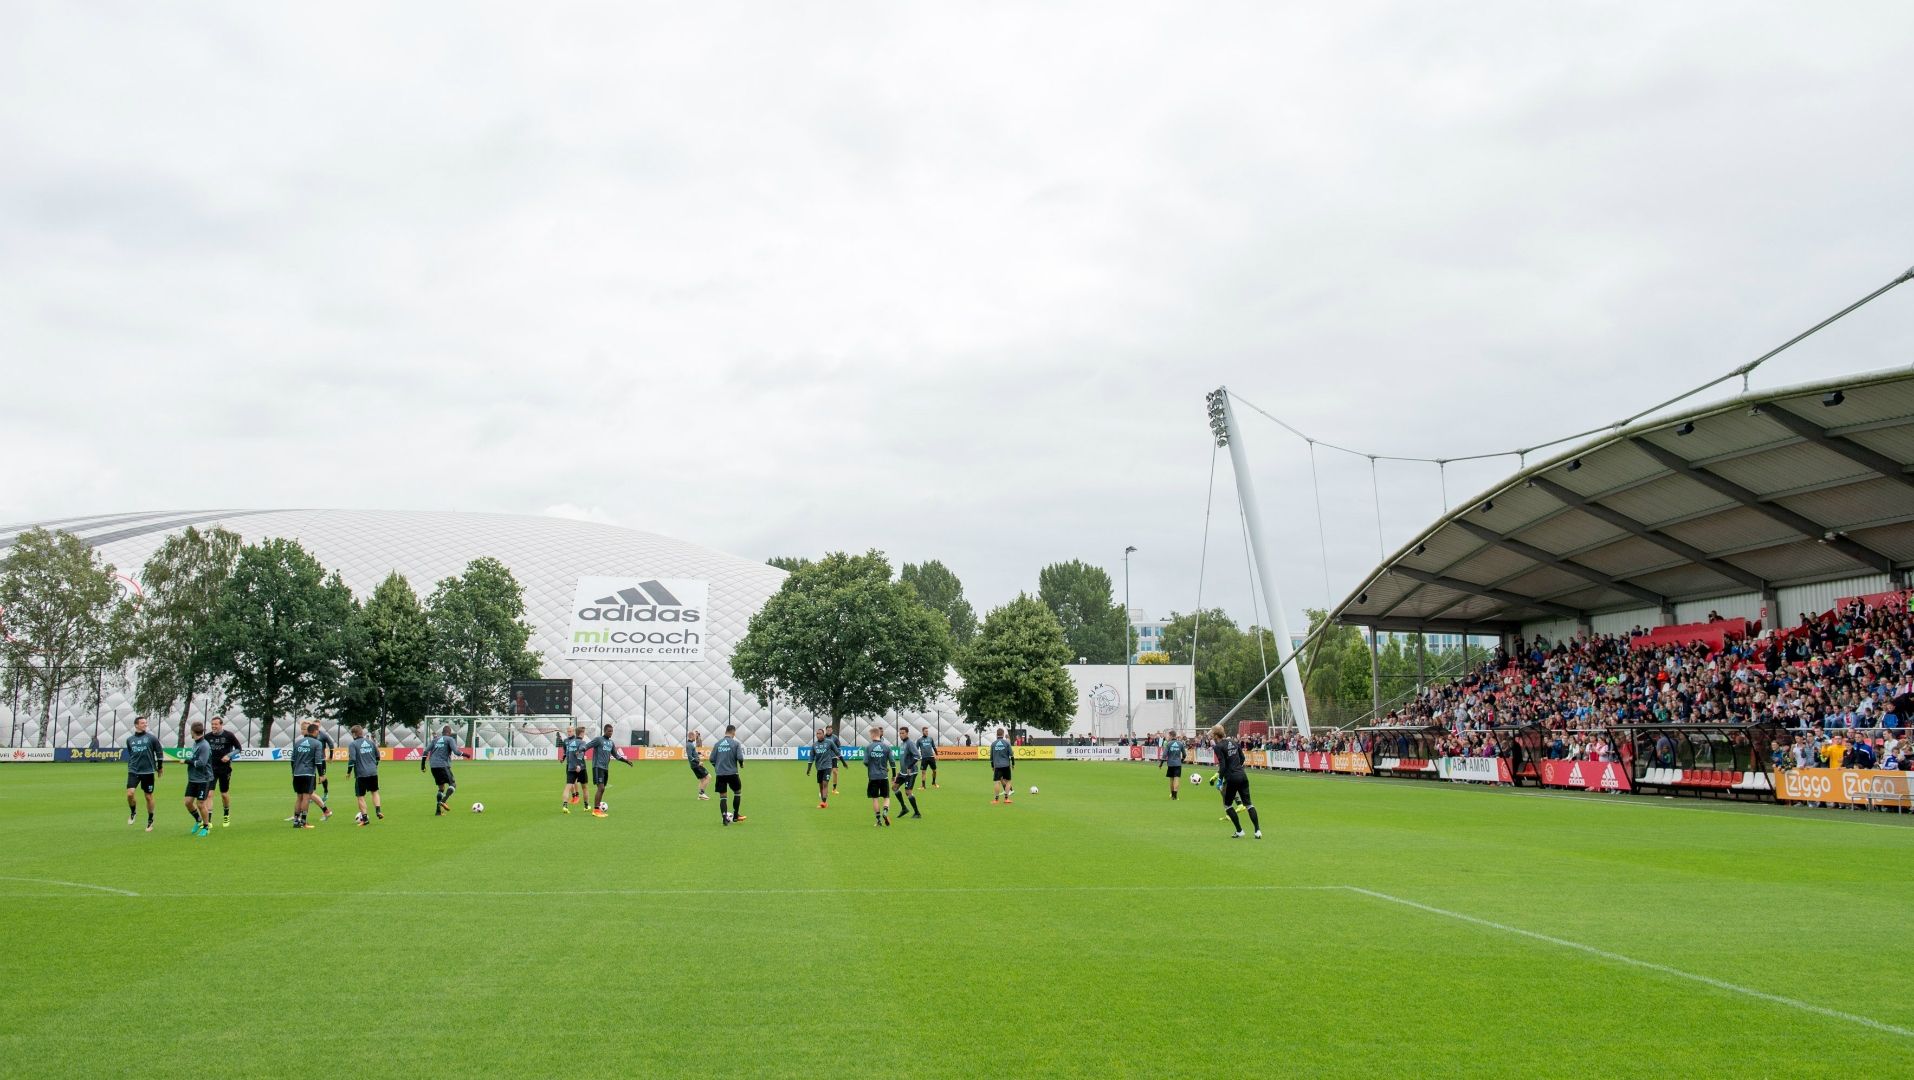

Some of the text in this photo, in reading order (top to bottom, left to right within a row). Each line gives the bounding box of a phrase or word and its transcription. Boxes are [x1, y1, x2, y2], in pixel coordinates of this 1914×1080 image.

[578, 604, 700, 623] adidas
[572, 645, 699, 654] performance centre
[70, 748, 123, 760] De Telegraaf
[1785, 770, 1831, 798] Ziggo
